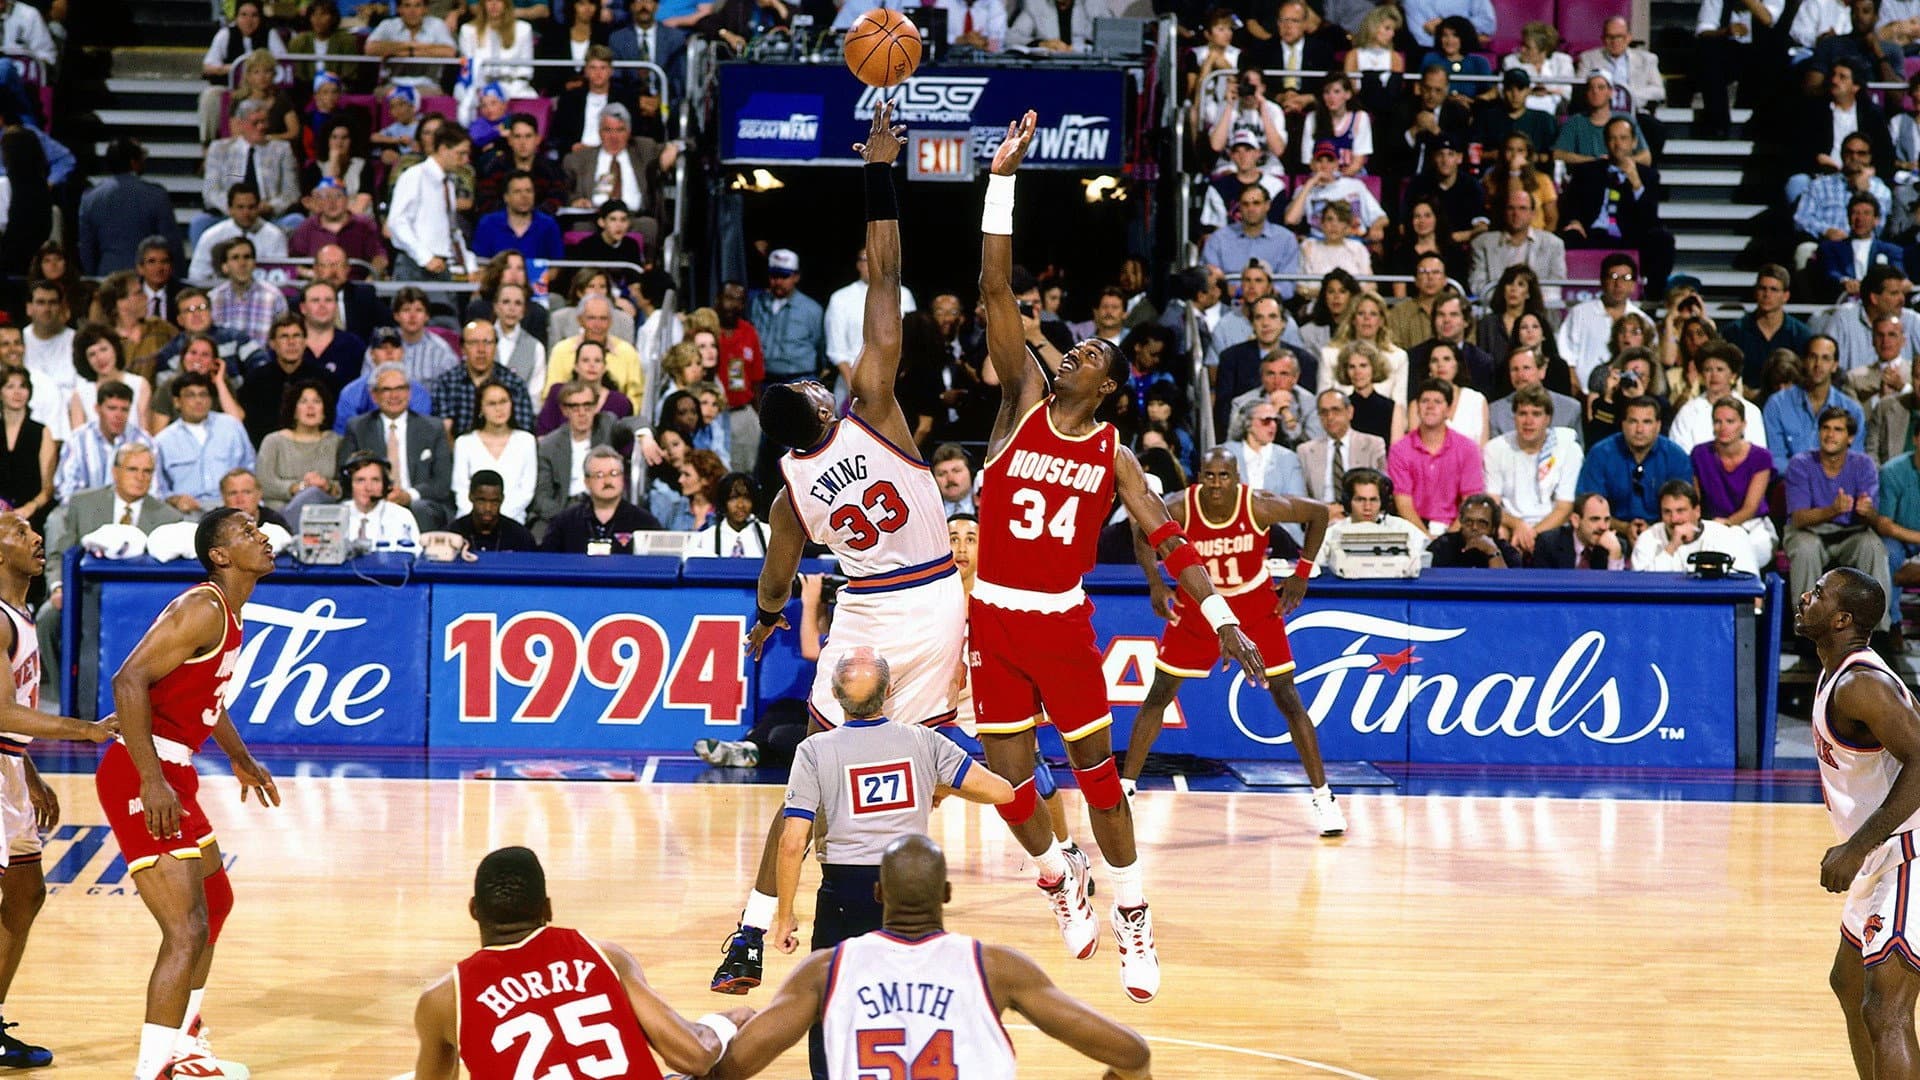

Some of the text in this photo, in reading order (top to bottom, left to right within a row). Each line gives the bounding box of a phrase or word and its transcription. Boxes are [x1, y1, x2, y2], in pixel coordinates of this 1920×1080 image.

[855, 77, 989, 112] MSG
[901, 110, 971, 122] NETWORK
[917, 137, 965, 174] EXIT
[1040, 115, 1110, 160] WFAN
[810, 455, 868, 507] EWING
[829, 479, 910, 551] 33
[1008, 488, 1080, 545] 34
[1194, 533, 1254, 557] OUSTON
[1205, 557, 1243, 585] 11
[223, 598, 391, 726] The
[444, 611, 747, 725] 1994
[1228, 610, 1669, 744] Finals
[863, 773, 901, 804] 27
[476, 959, 597, 1019] HORRY
[857, 982, 955, 1021] SMITH
[491, 993, 629, 1080] 25
[856, 1028, 959, 1080] 54
